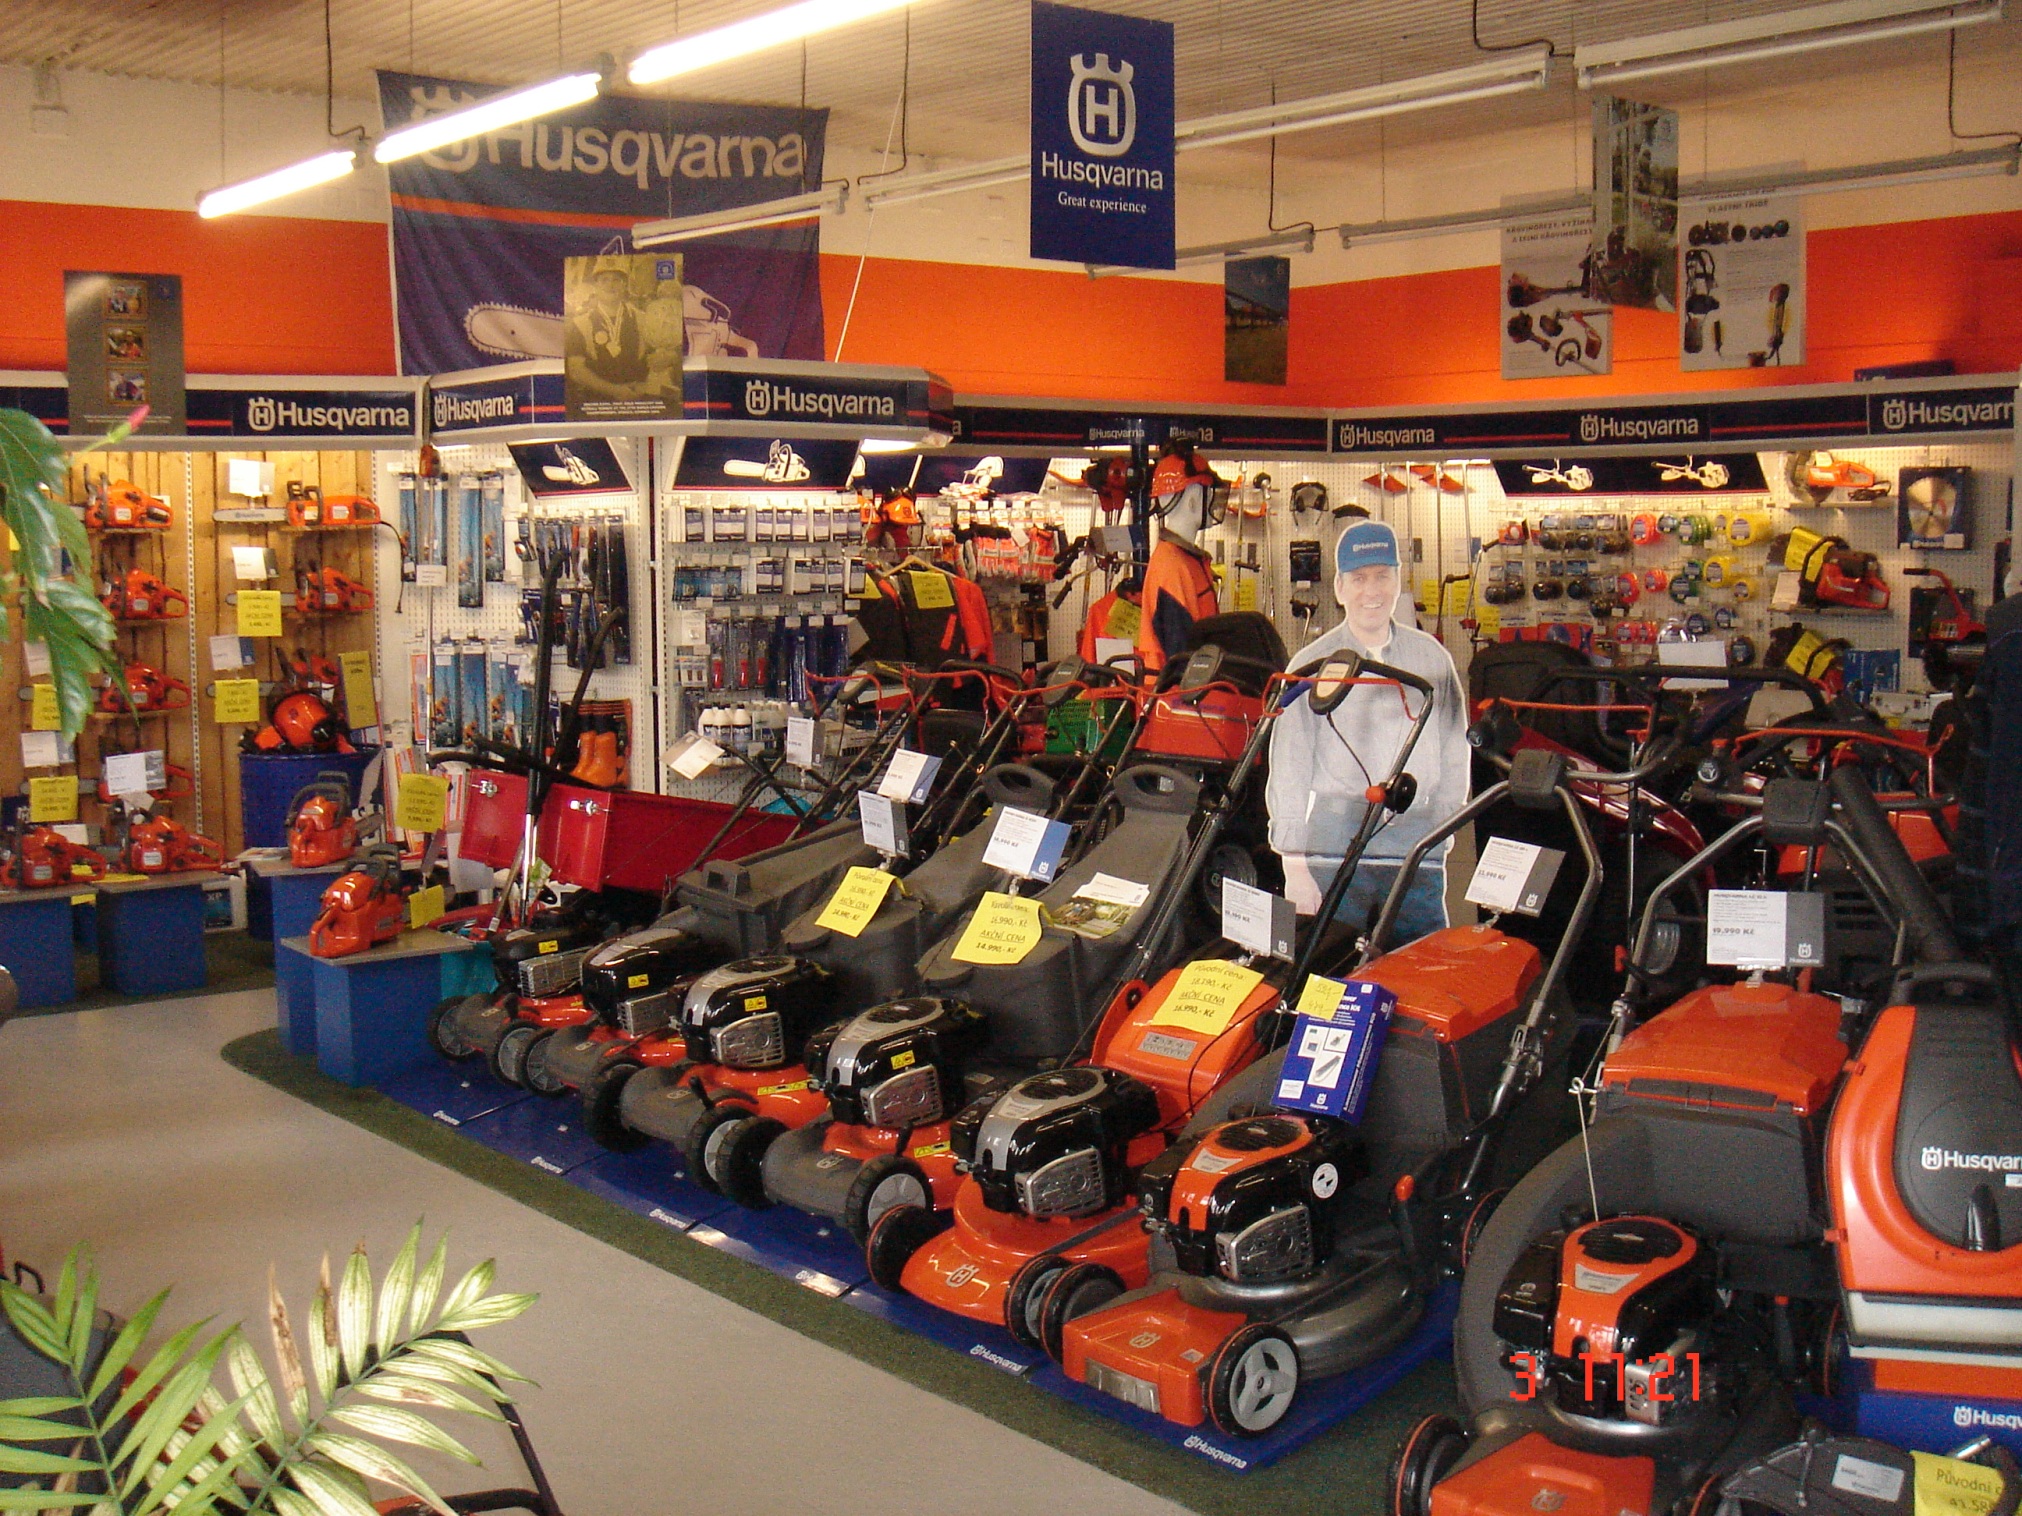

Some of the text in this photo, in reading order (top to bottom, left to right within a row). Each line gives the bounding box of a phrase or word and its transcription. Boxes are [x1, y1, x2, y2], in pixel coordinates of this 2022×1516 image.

[486, 118, 807, 190] Husqvarna
[1041, 151, 1164, 190] Husqvarna
[1058, 191, 1147, 214] Great experience
[447, 393, 514, 423] Husqvarna
[774, 385, 895, 418] Husqvarna
[277, 402, 410, 431] Husqvarna
[1600, 415, 1699, 440] Husqvarna
[1356, 425, 1435, 448] Husqvarna
[1006, 933, 1026, 942] CENA
[1712, 927, 1740, 935] 19.990
[1203, 992, 1226, 1004] CENA
[1203, 1007, 1215, 1017] Kč
[981, 1347, 1022, 1372] Husqvarna
[1195, 1438, 1247, 1470] Husqvarna
[1936, 1468, 1991, 1493] Původní
